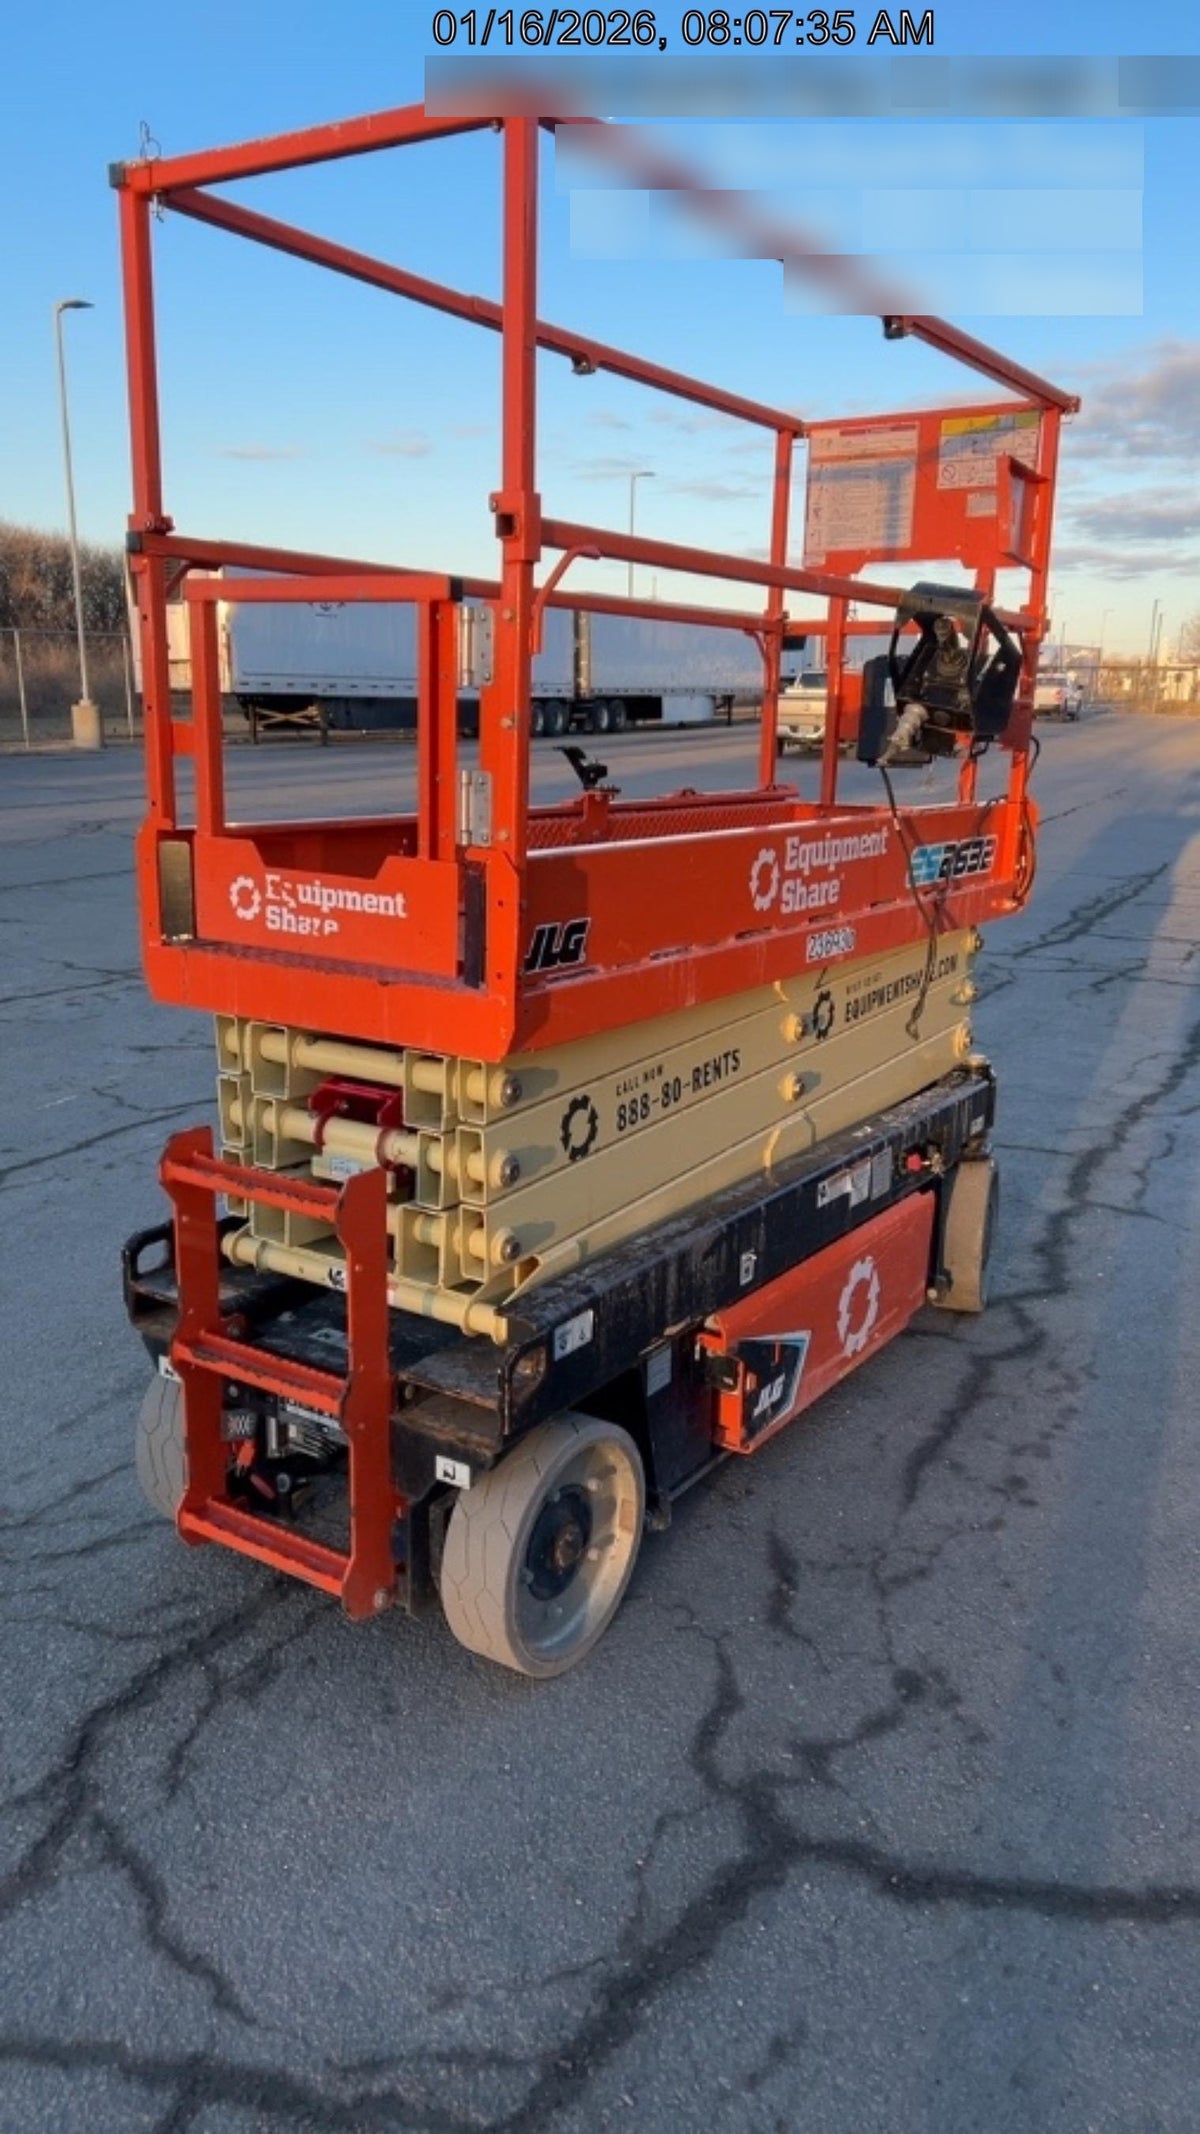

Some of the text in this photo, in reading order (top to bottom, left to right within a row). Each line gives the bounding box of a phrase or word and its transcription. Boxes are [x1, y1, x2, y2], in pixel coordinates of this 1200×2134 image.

[785, 826, 889, 876] Equipment
[781, 878, 840, 914] Share
[520, 917, 591, 975] JLG
[616, 1049, 742, 1132] 888-80-RENTS
[753, 1372, 786, 1417] JLG
